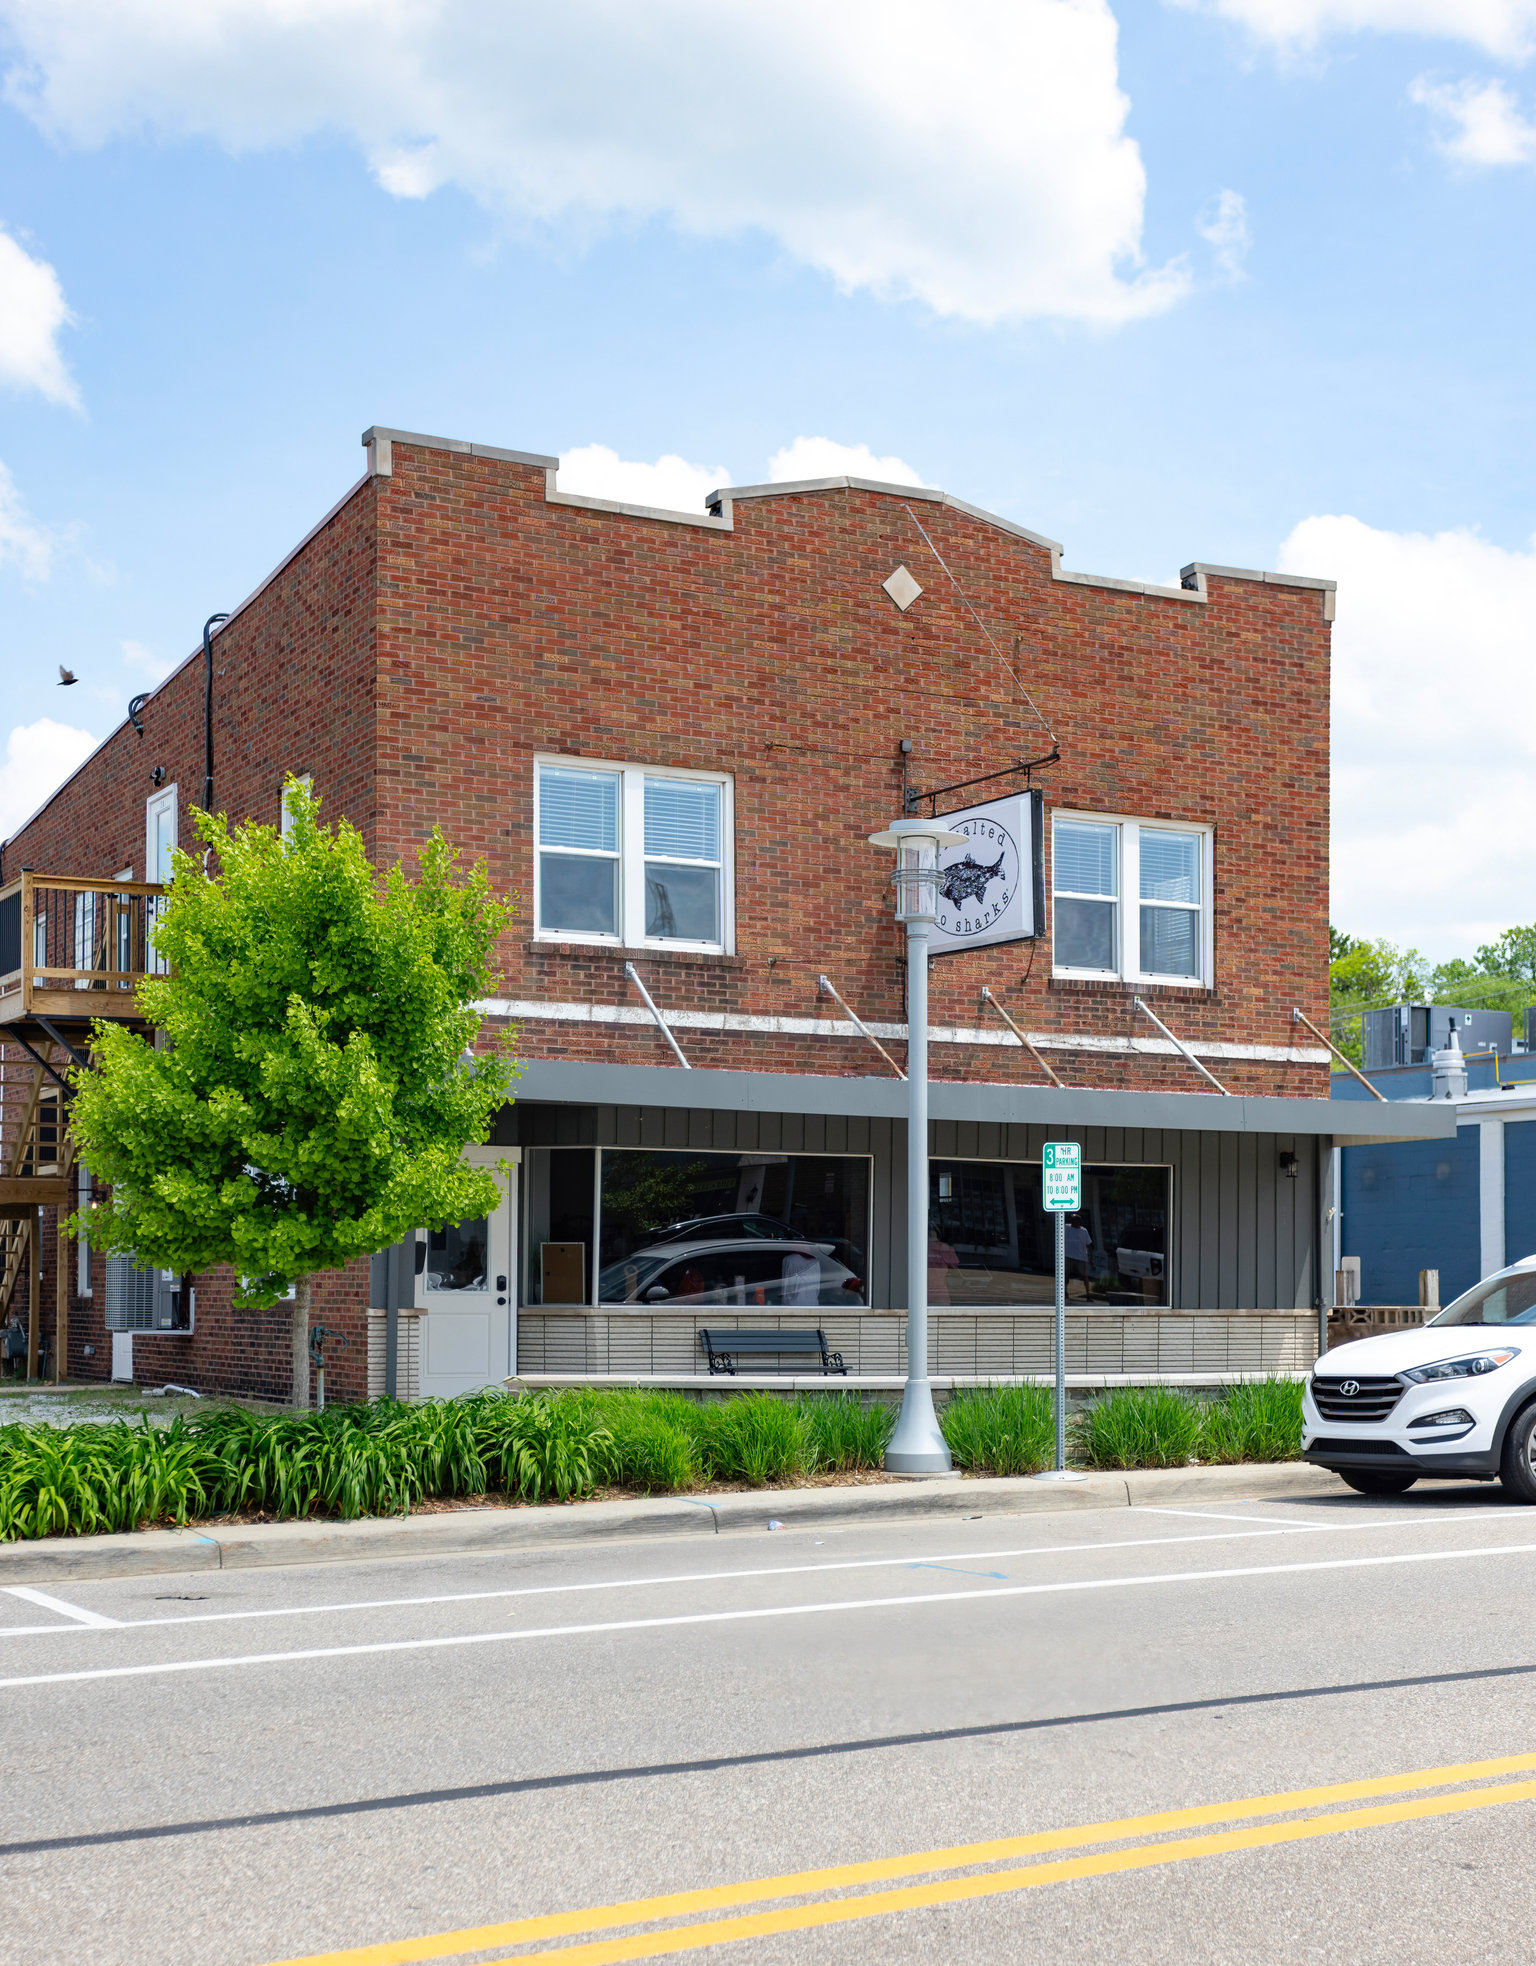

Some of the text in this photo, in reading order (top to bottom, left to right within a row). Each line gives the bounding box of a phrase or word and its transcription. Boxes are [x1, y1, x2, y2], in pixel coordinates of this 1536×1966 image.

[955, 821, 1006, 847] alted
[955, 891, 1009, 932] sharks
[1046, 1147, 1072, 1165] 3 HR
[1056, 1157, 1078, 1166] PARKING
[1066, 1173, 1075, 1182] AM
[1047, 1185, 1054, 1194] TO
[1070, 1185, 1078, 1194] PM
